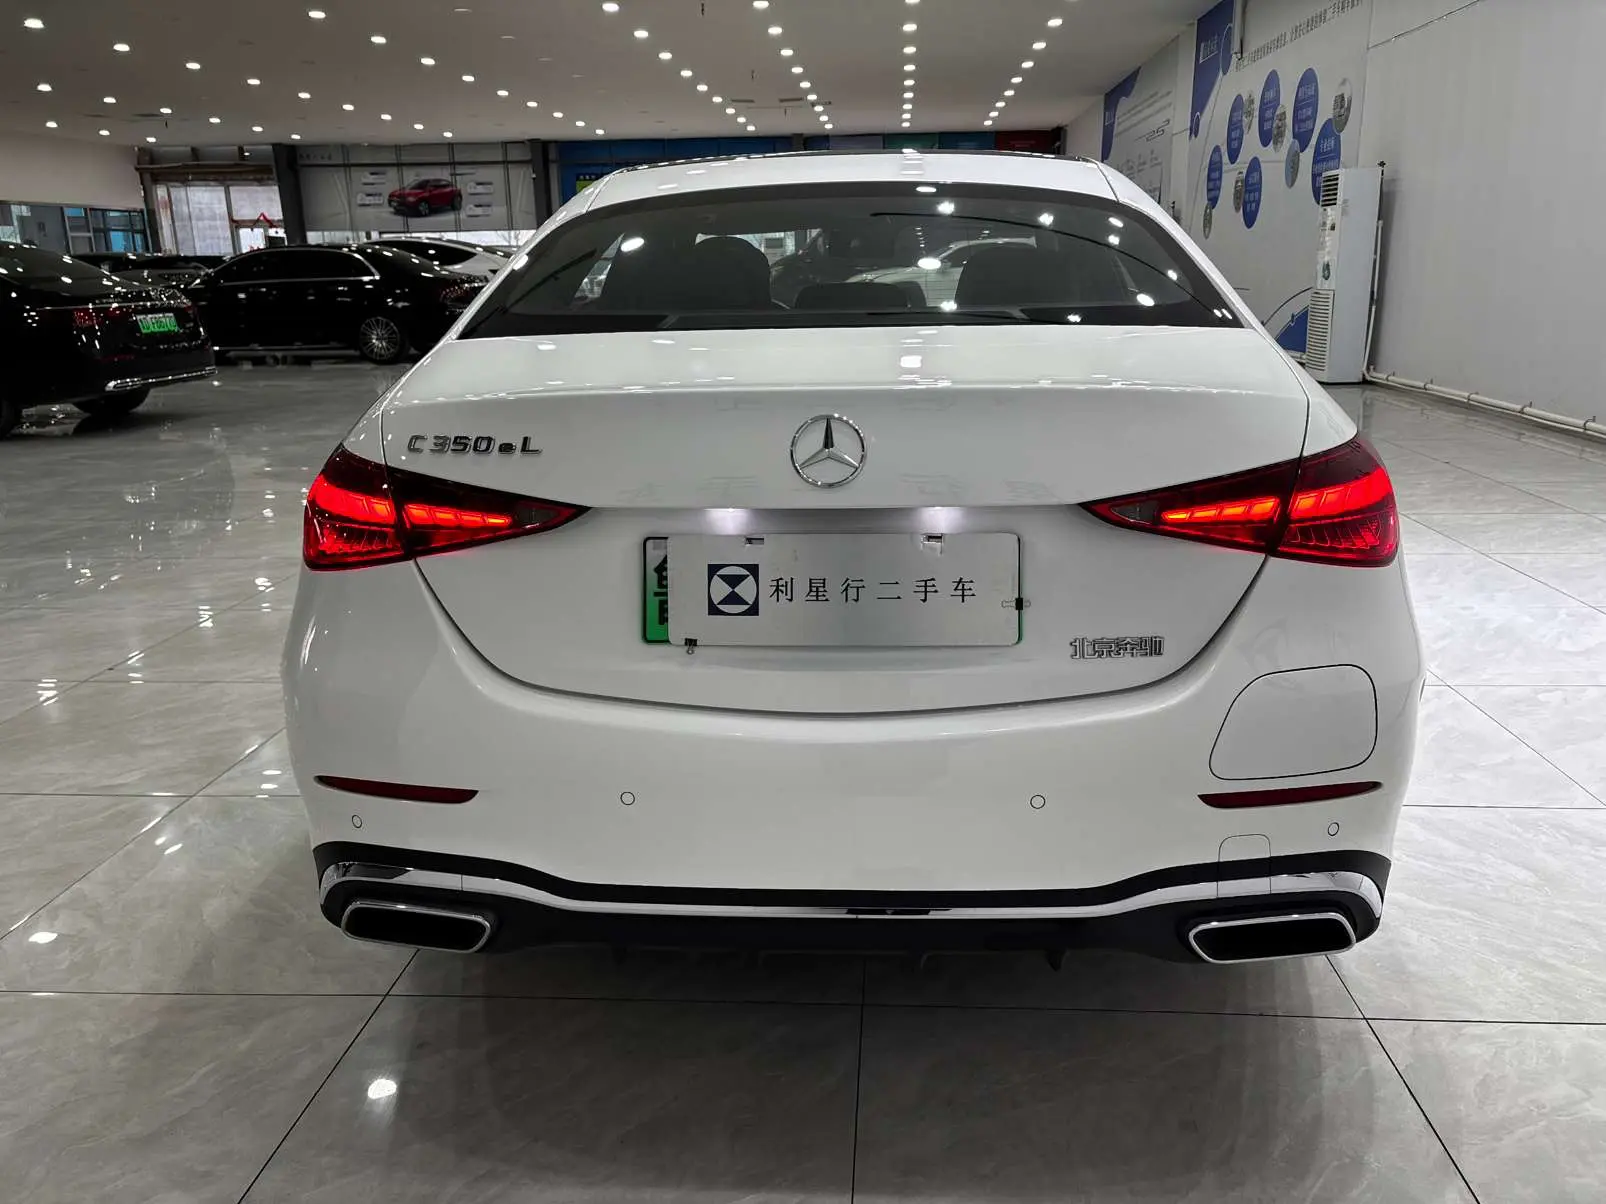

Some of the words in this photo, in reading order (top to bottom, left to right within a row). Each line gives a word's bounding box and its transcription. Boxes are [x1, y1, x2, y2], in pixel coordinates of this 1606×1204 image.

[769, 576, 976, 603] 利星行二手车
[1069, 636, 1165, 659] 北京奔驰
